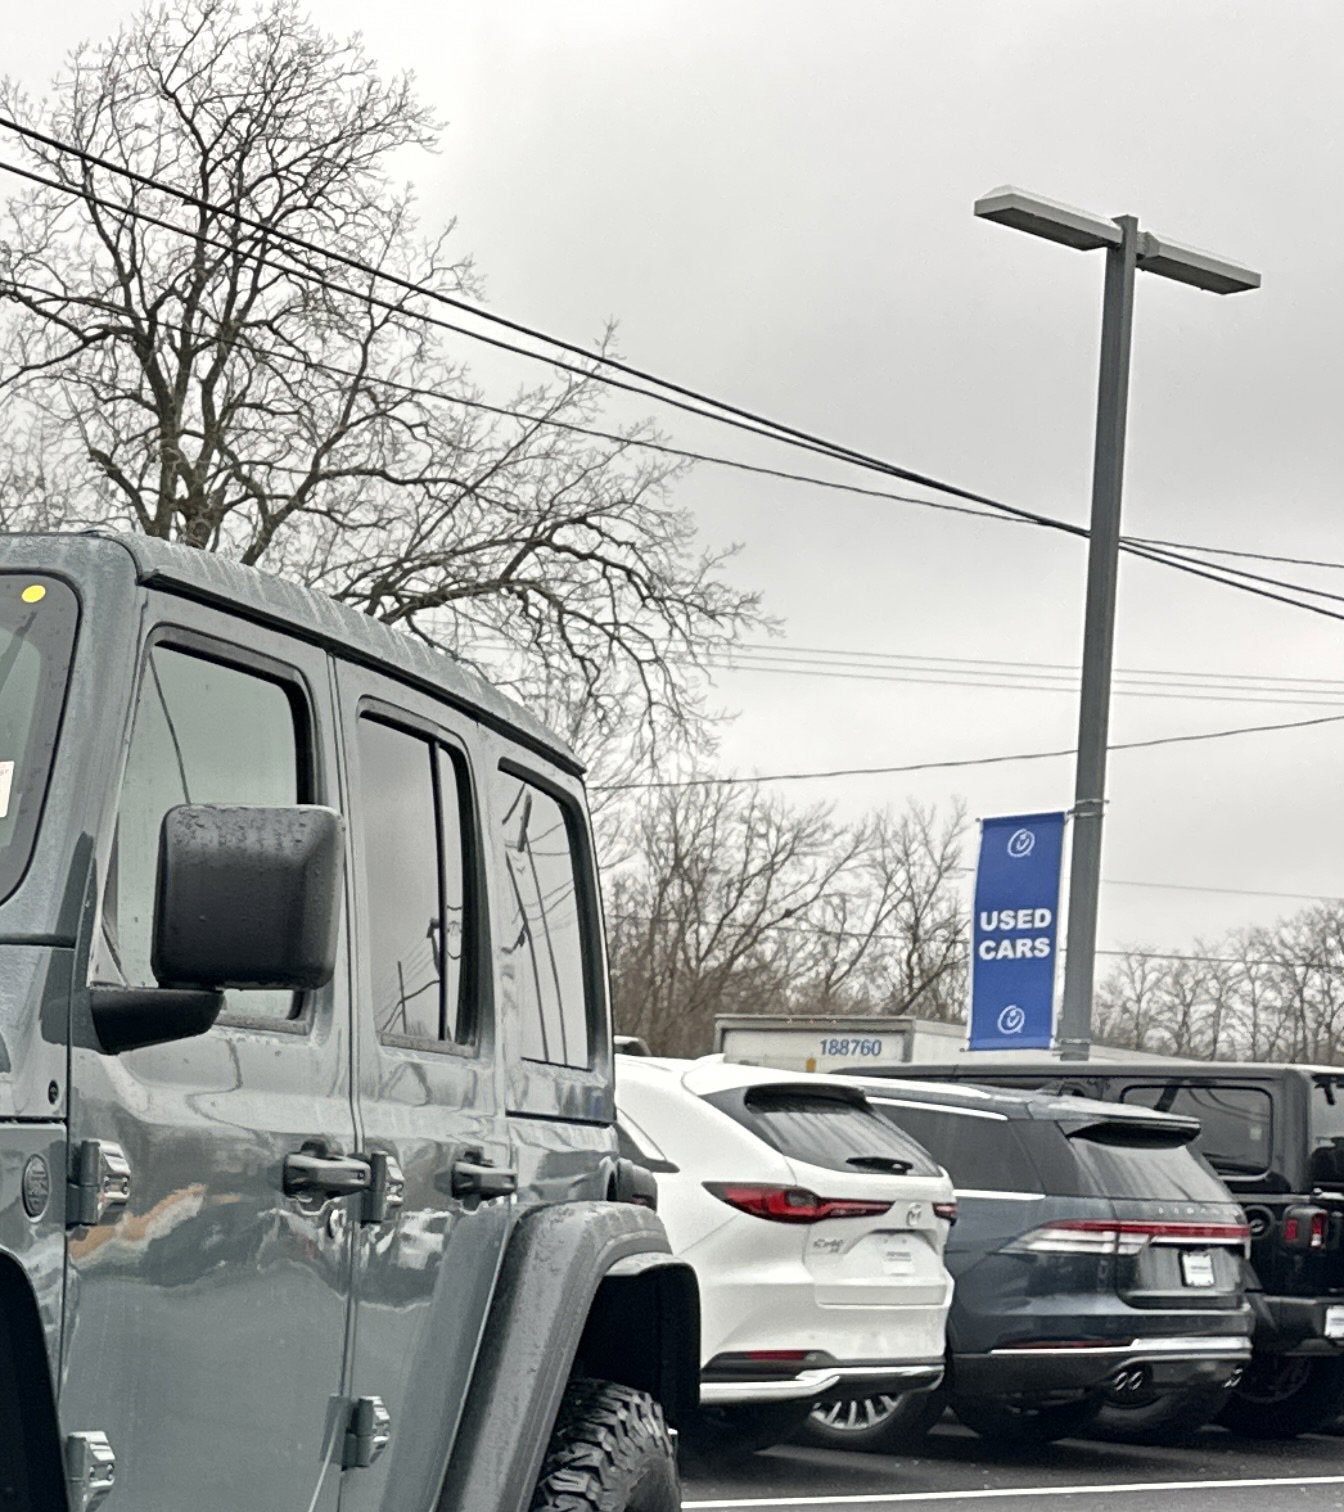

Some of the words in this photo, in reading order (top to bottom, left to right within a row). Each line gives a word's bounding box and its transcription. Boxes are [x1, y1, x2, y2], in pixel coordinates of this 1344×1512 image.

[979, 907, 1052, 932] USED
[978, 937, 1051, 961] CARS
[819, 1038, 883, 1057] 188760
